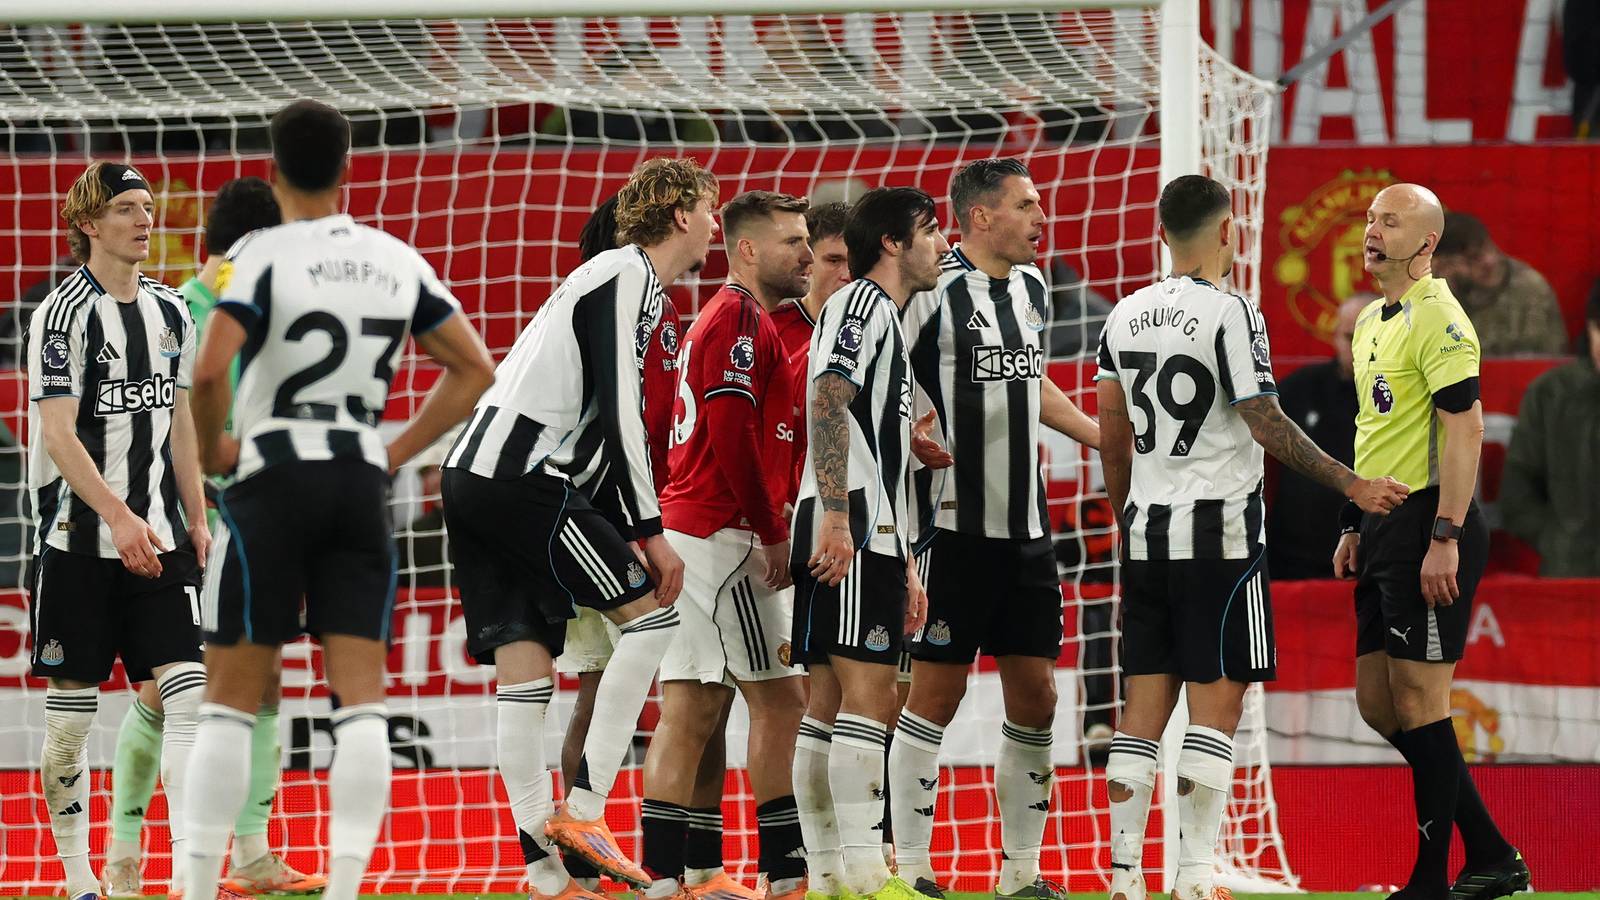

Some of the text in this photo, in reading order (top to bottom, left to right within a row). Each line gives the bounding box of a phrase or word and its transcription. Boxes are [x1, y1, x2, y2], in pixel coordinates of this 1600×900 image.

[306, 257, 403, 297] MURPHY
[1128, 307, 1199, 342] BRUNO G.
[272, 311, 408, 428] 23
[124, 376, 175, 410] sela
[1119, 351, 1216, 457] 39
[1466, 603, 1506, 648] A
